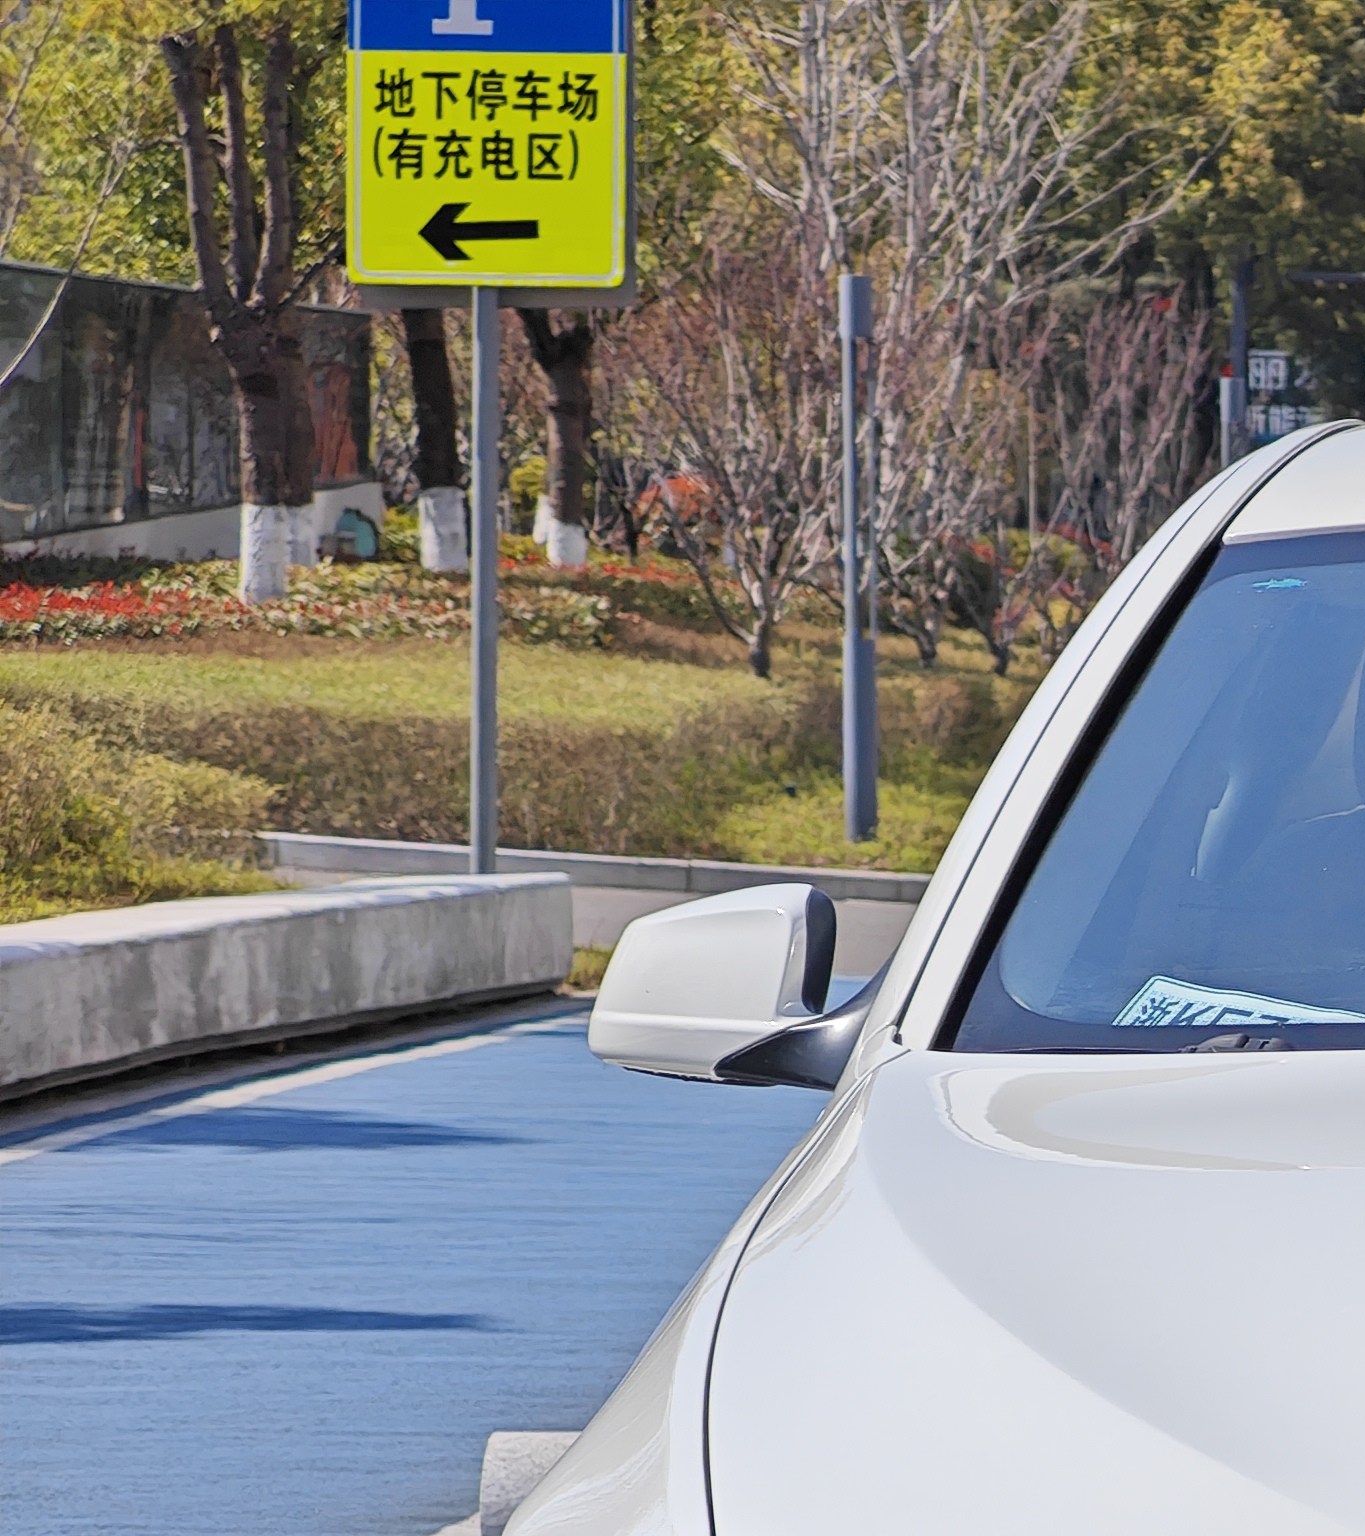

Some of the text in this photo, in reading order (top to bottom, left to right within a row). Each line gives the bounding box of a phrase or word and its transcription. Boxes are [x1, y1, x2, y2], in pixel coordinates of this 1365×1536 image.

[373, 68, 599, 122] 地下停车场
[373, 126, 579, 181] (有充电区)
